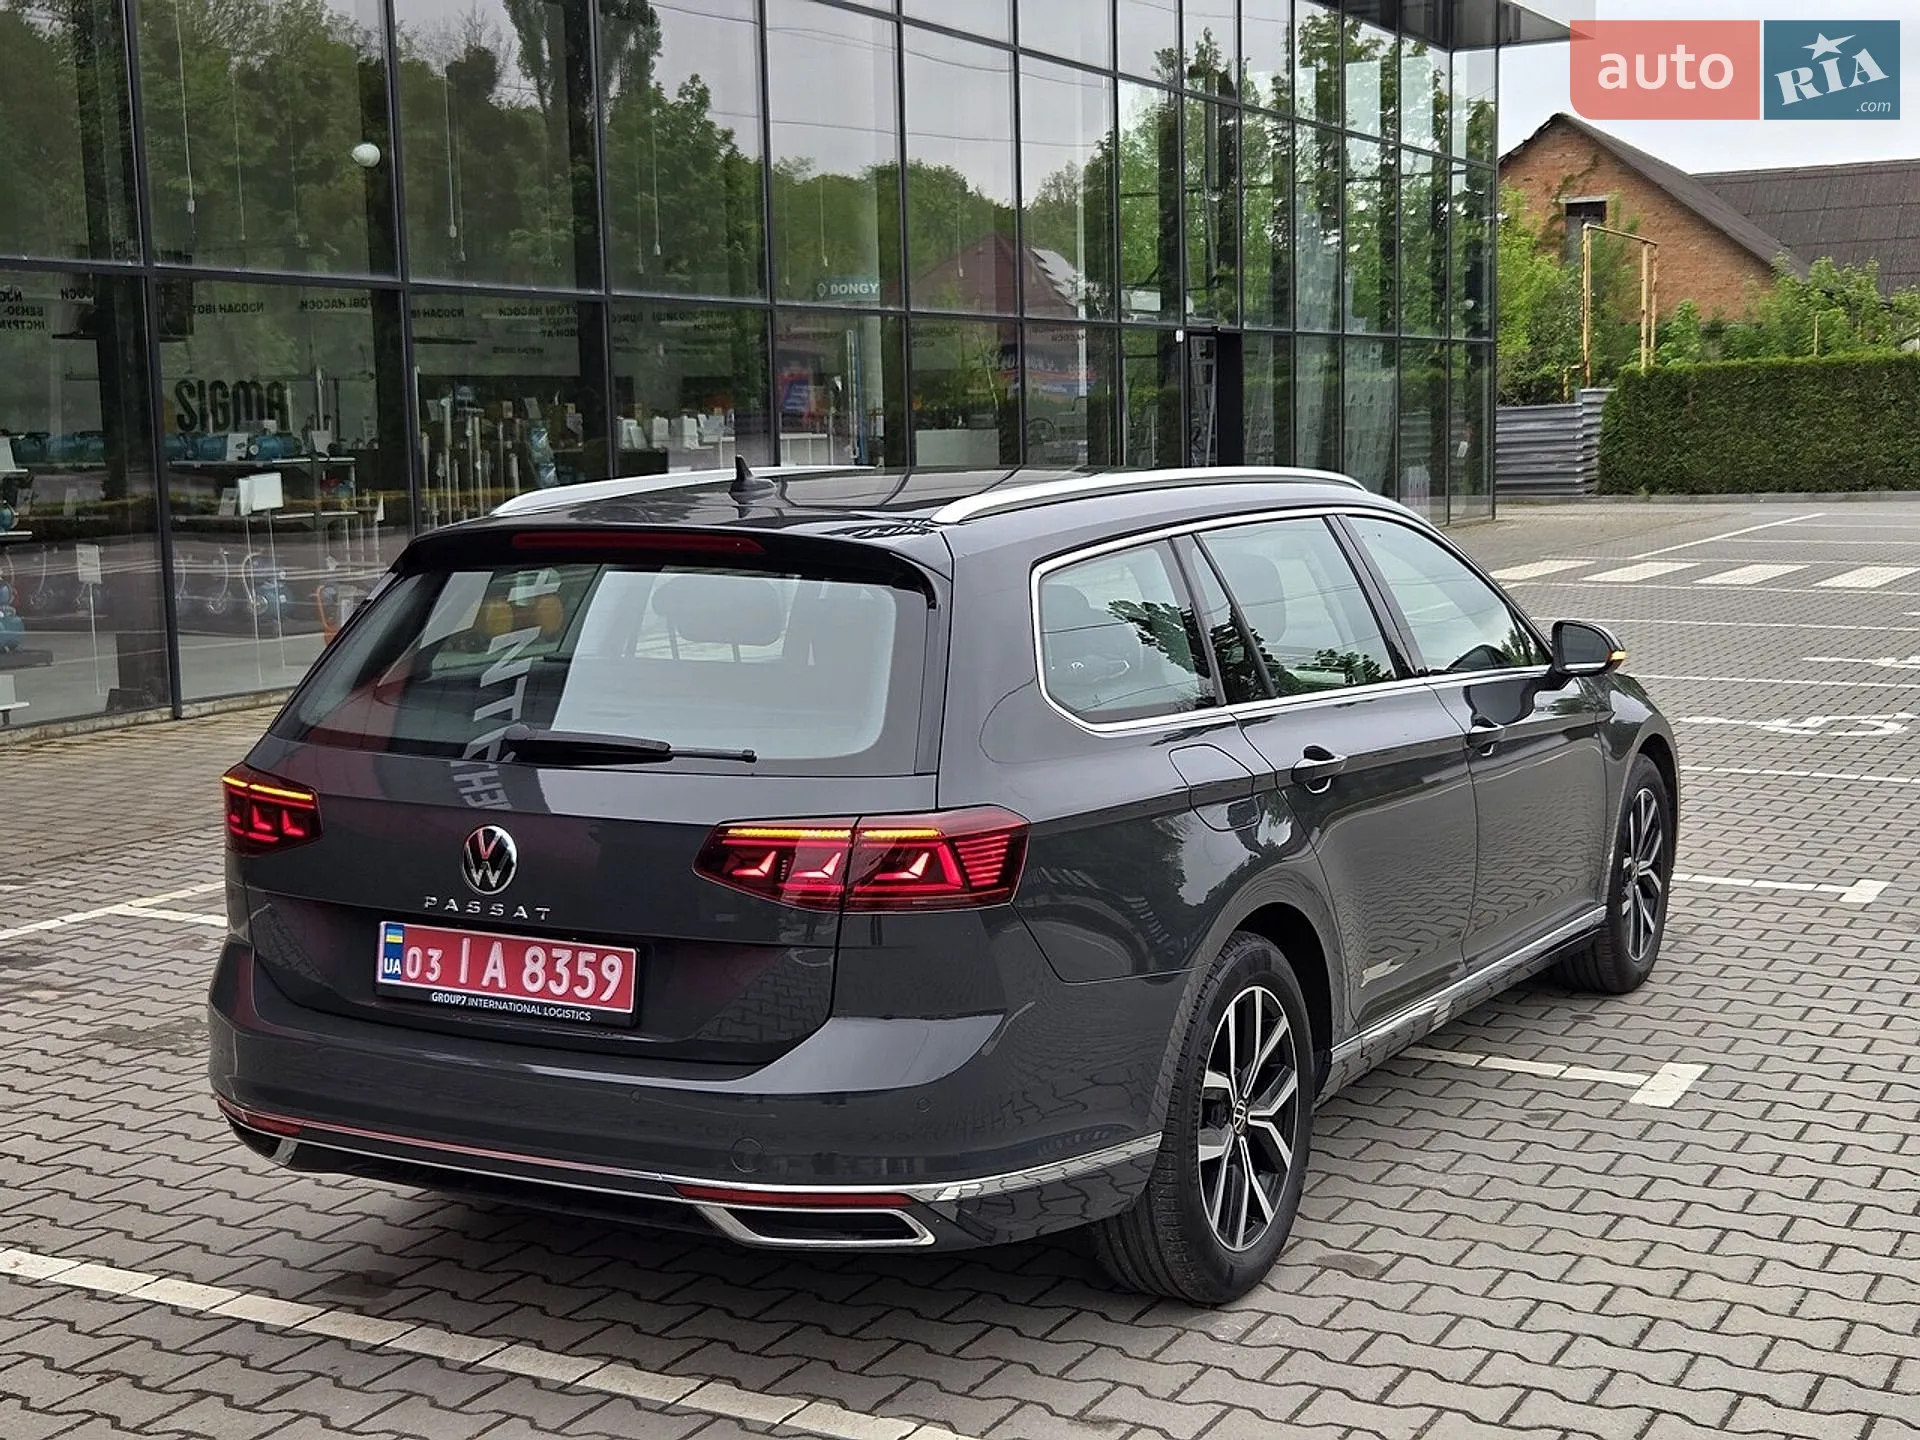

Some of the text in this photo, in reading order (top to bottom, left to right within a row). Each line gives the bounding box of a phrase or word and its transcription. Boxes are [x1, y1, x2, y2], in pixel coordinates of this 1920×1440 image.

[830, 283, 879, 295] DONGY
[175, 380, 290, 432] SIGMA
[423, 895, 551, 921] PASSAT
[384, 957, 402, 974] UA
[406, 946, 443, 982] 03
[522, 945, 623, 1002] 8359
[431, 991, 592, 1022] GROUP7 INTERNATIONAL LOGISTICS
